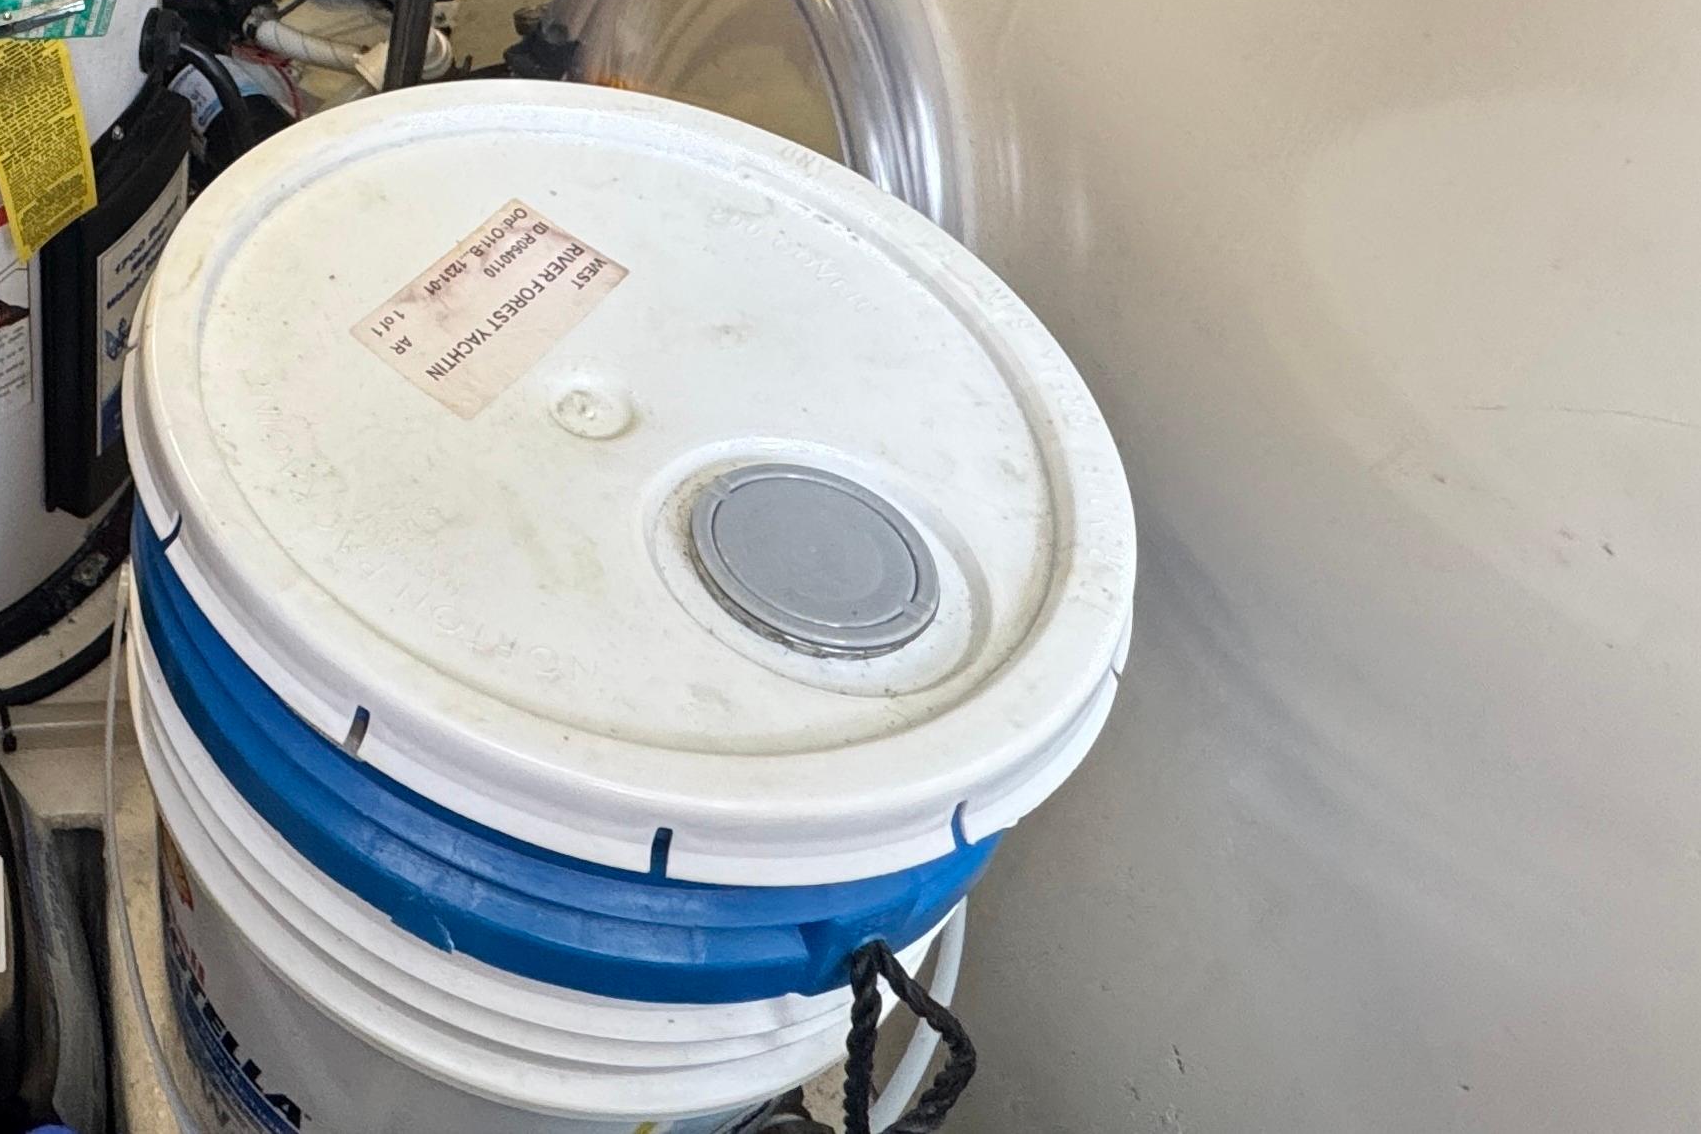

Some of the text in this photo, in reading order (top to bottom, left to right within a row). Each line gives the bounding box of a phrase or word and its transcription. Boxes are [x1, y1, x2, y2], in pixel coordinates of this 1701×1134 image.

[504, 207, 528, 230] Ord:
[483, 222, 549, 278] ID R0640110
[571, 257, 608, 290] WEST
[371, 310, 405, 338] 1 of 1
[425, 242, 585, 382] RIVER FOREST YACHTIN
[390, 336, 413, 355] AR
